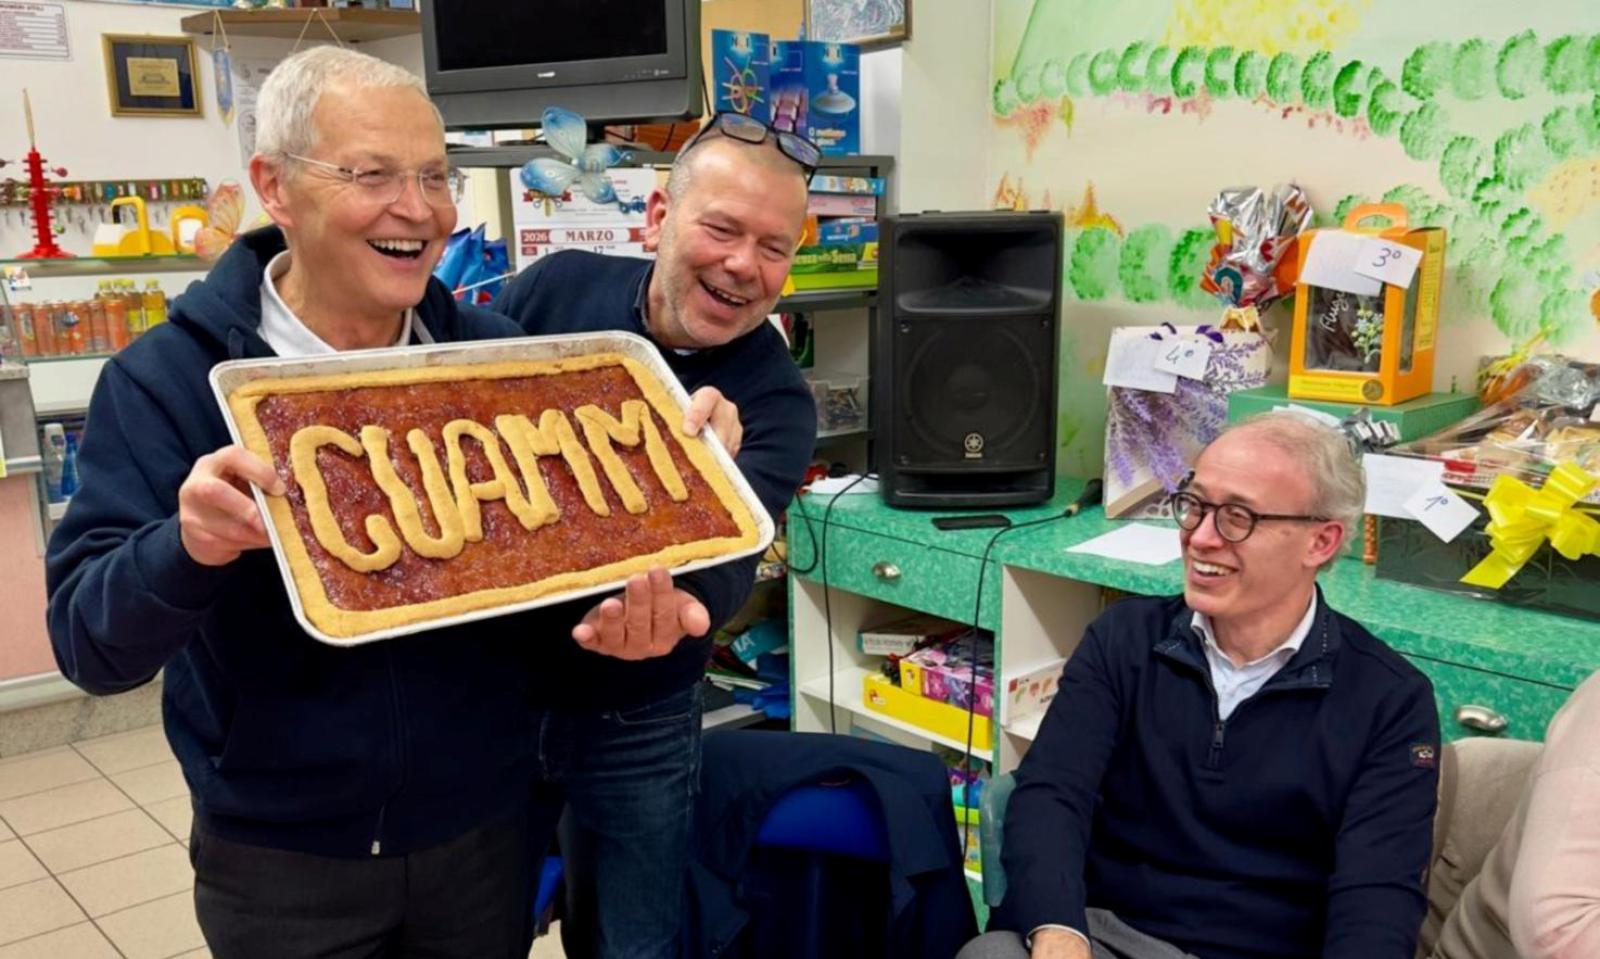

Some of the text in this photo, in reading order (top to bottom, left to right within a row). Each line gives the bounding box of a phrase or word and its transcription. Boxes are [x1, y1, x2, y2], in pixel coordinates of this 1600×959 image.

[522, 230, 614, 243] 2026 MARZO
[289, 400, 689, 573] CUAMM
